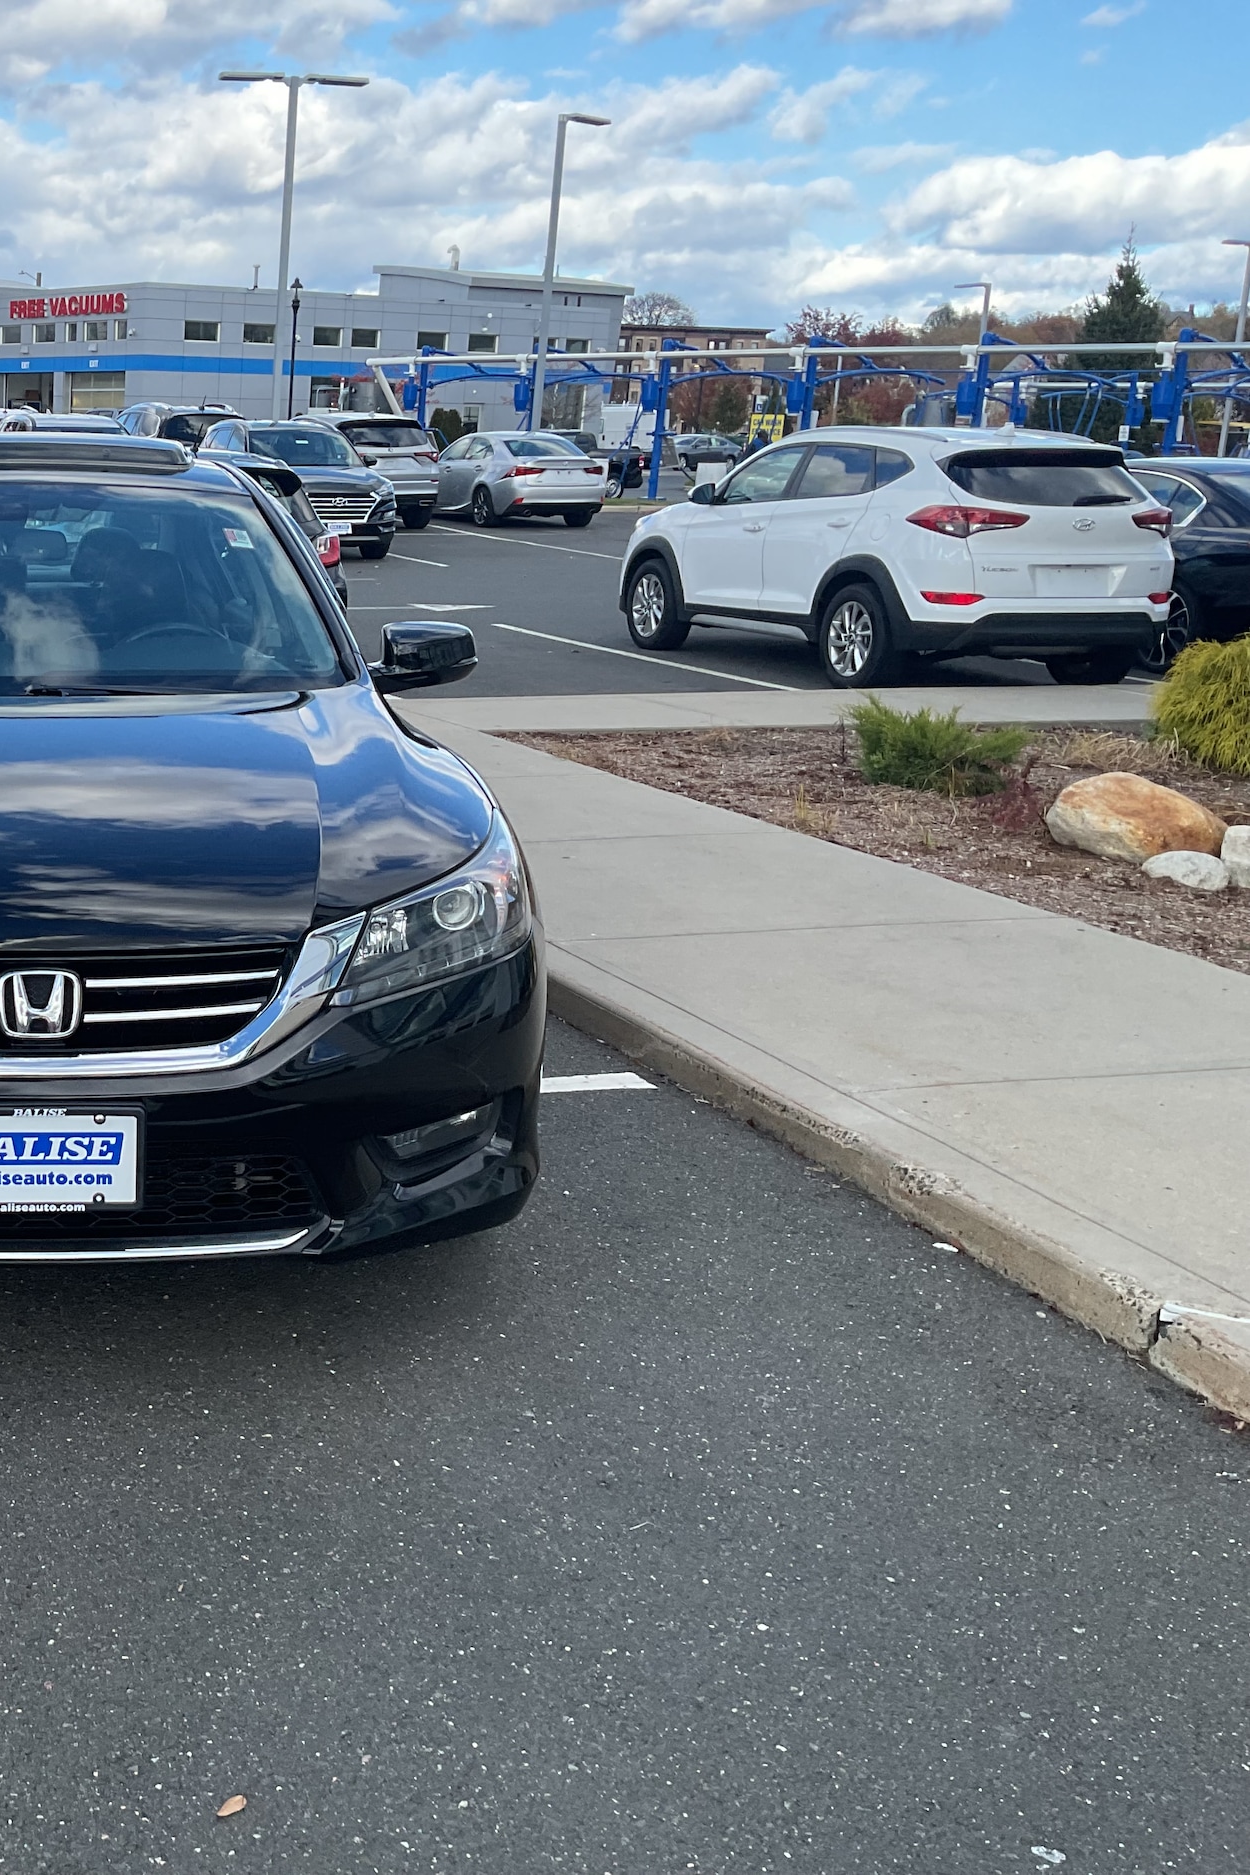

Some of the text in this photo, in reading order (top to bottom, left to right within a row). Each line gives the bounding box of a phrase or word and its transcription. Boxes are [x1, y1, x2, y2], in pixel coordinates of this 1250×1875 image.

[9, 292, 128, 319] FREE VACUUMS
[12, 1108, 68, 1118] BALISE
